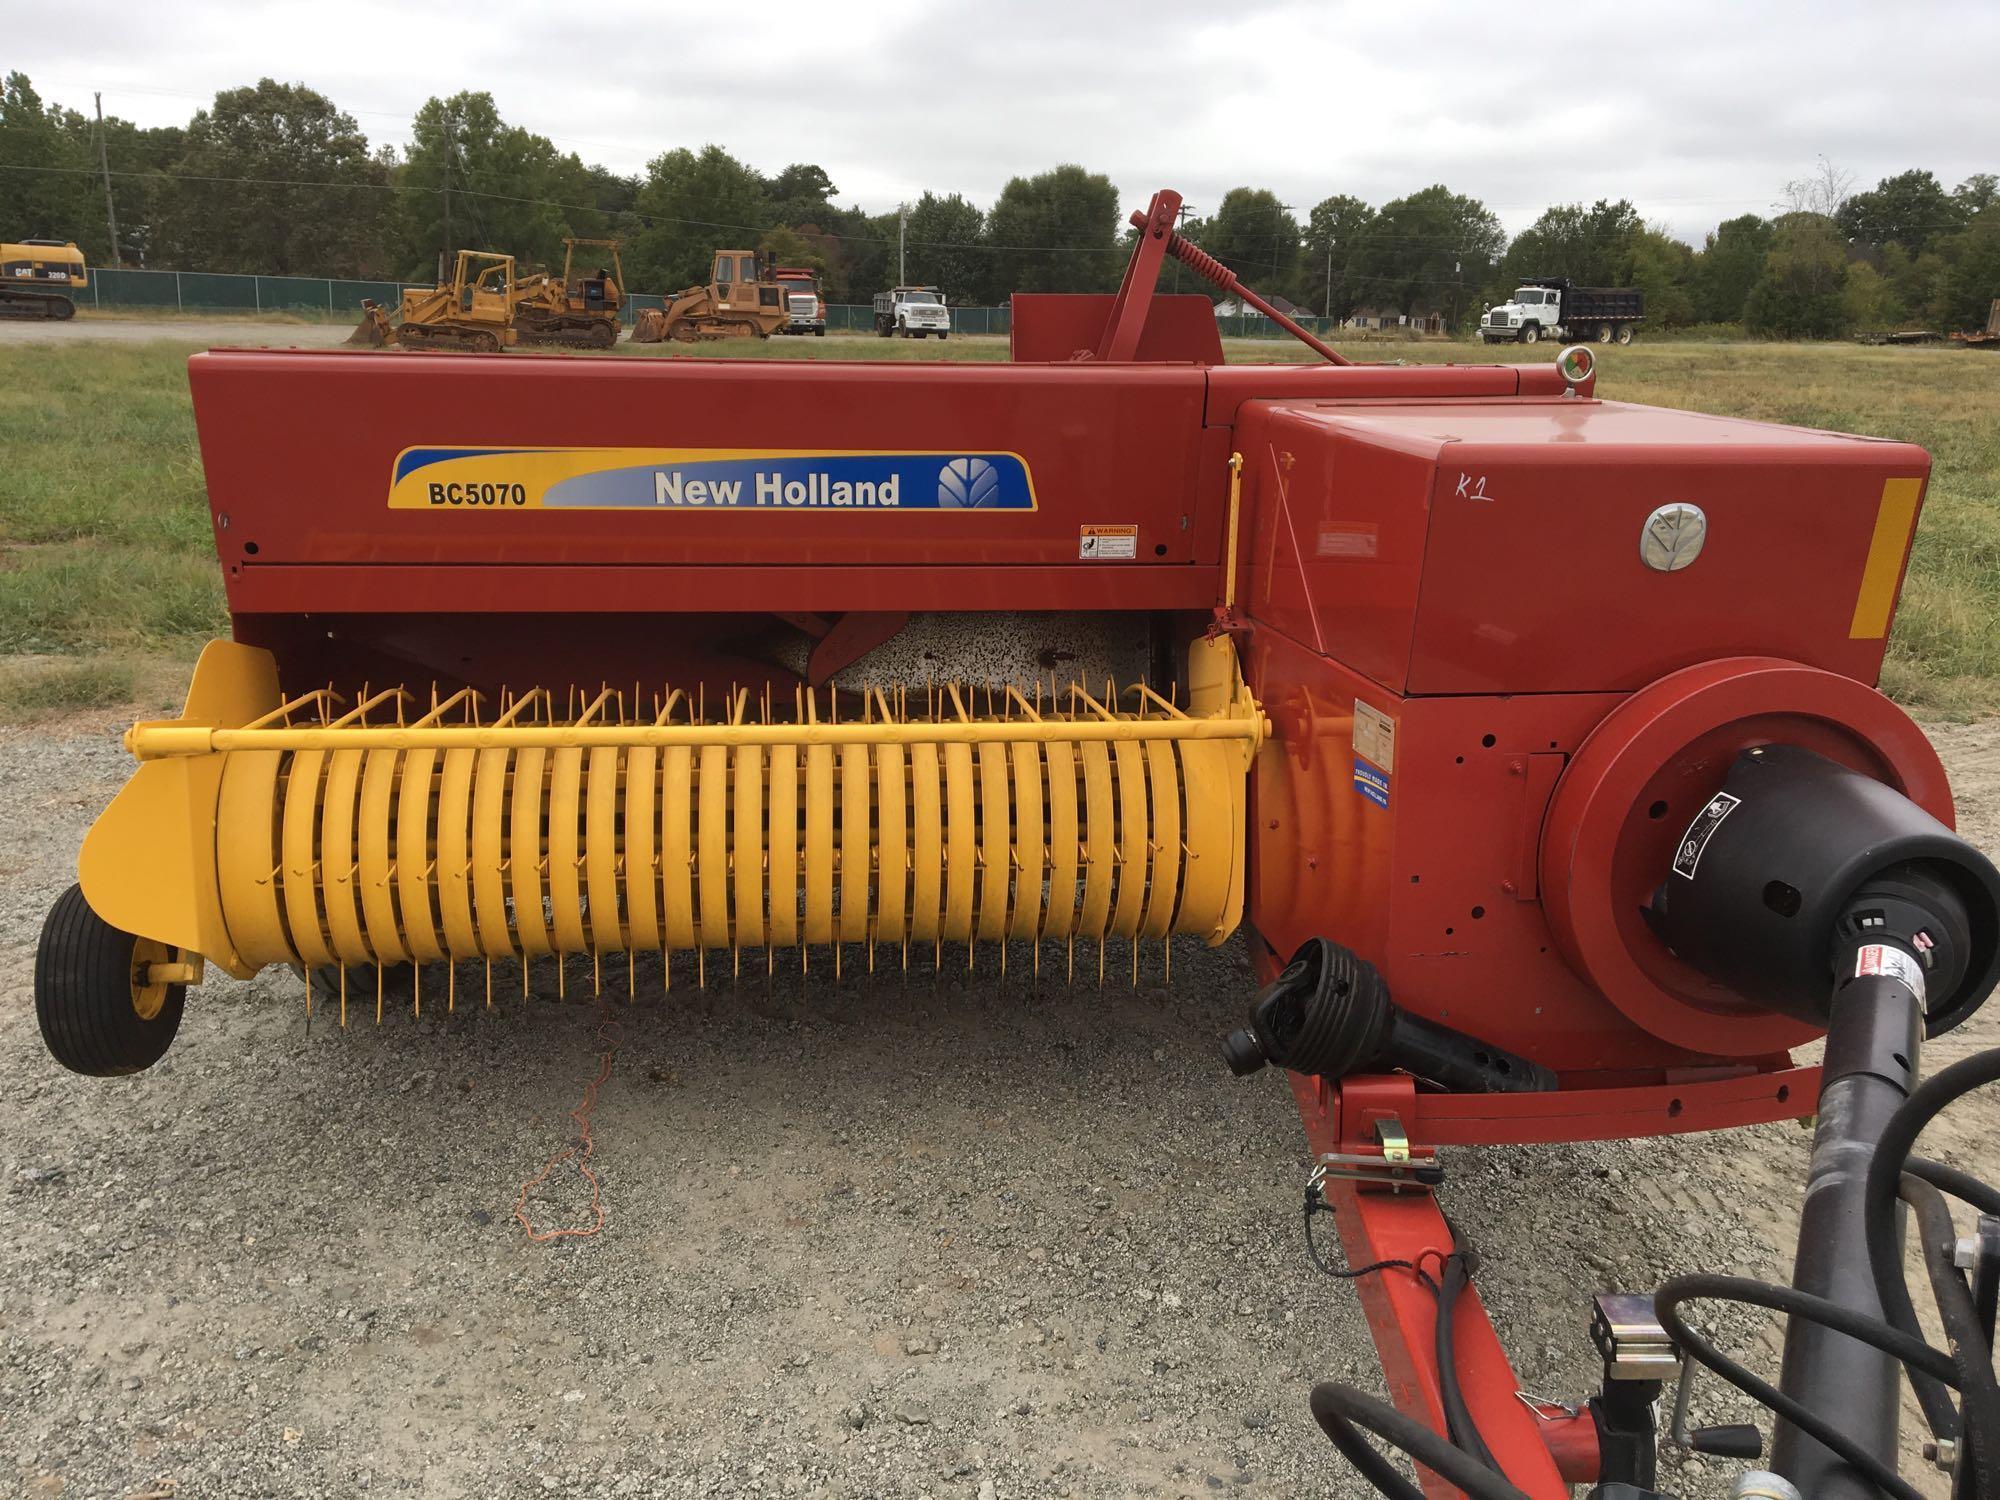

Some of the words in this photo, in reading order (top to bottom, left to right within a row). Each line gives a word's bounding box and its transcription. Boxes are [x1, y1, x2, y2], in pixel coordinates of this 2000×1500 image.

[15, 267, 33, 277] CAT
[428, 482, 526, 506] BC5070
[654, 472, 742, 505] New
[754, 472, 900, 506] Holland
[1096, 527, 1132, 535] WARNING
[1371, 775, 1383, 786] MADE
